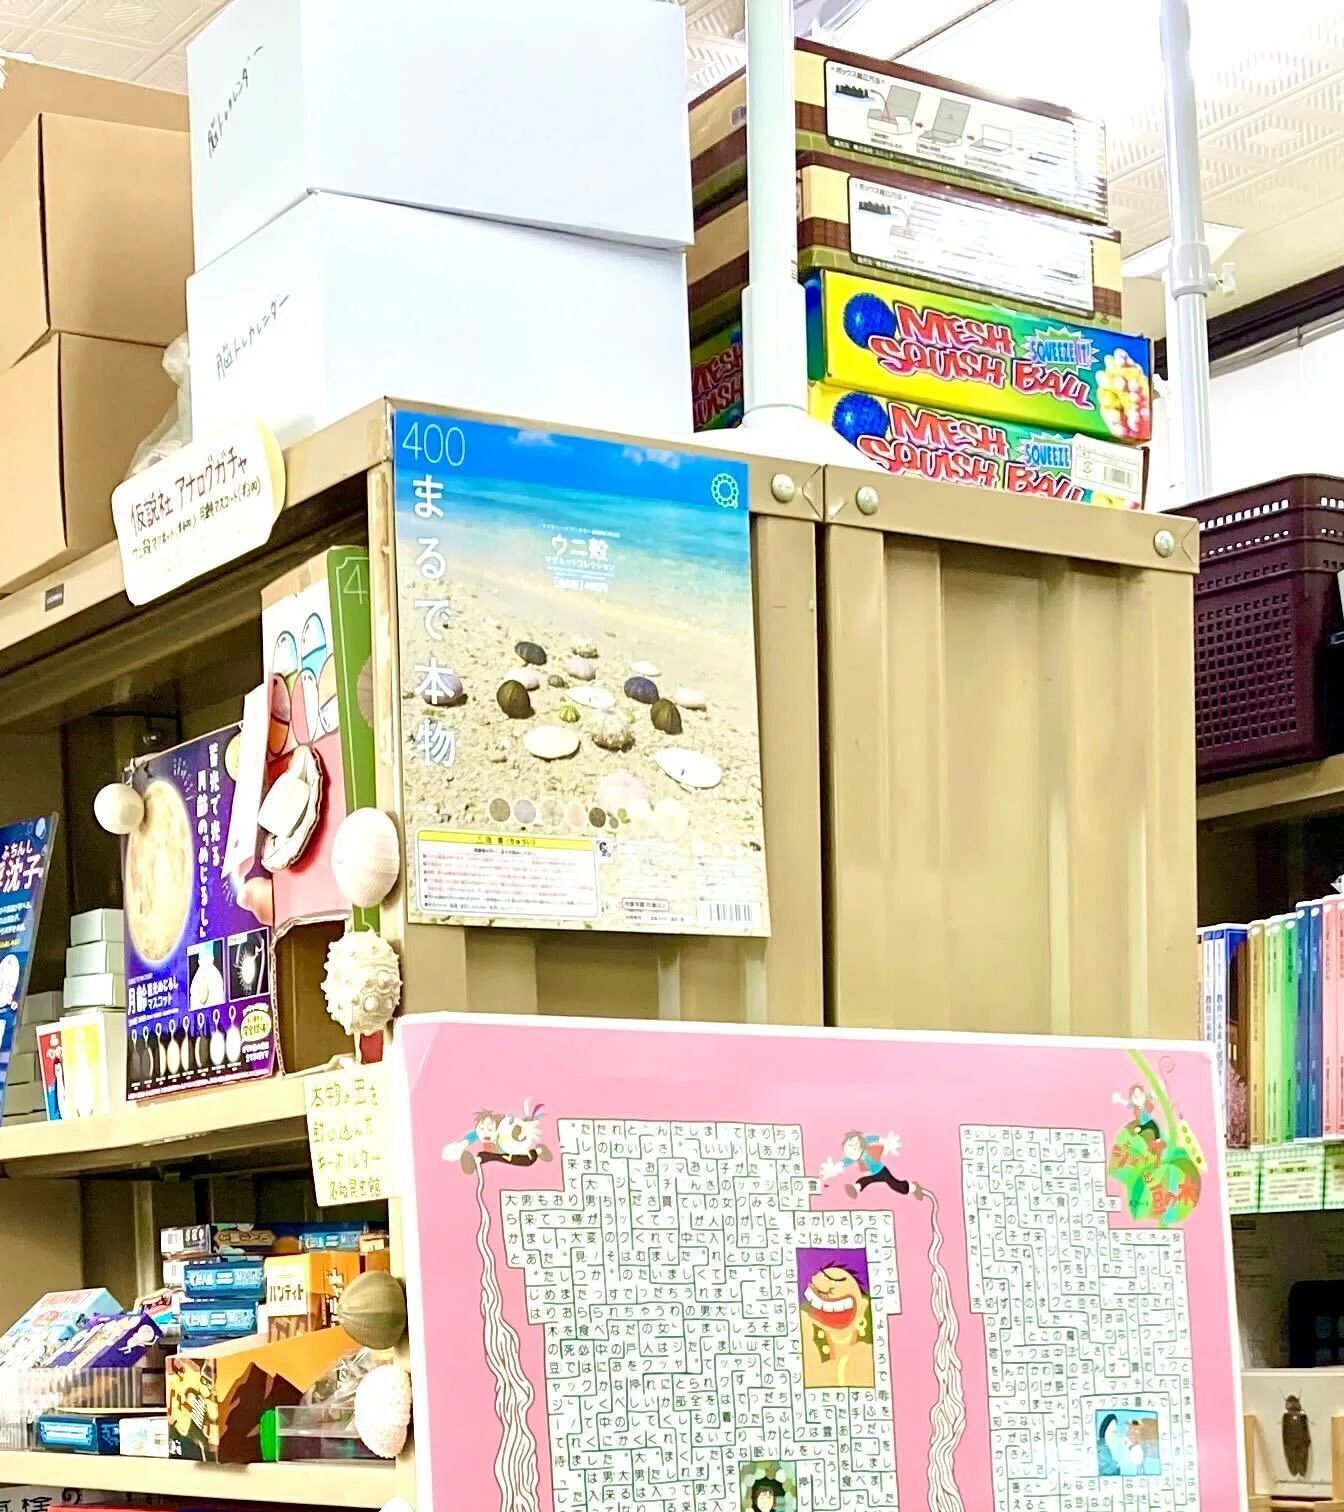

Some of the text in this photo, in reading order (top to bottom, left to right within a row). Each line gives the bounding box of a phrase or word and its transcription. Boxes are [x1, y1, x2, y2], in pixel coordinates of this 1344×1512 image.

[892, 303, 1013, 356] MESH
[1029, 338, 1078, 366] SQUEEZE
[868, 336, 1094, 411] SQUISH BALL
[401, 422, 466, 467] 400
[888, 402, 1011, 458] MESH
[858, 436, 1084, 503] SQUISH BALL
[551, 535, 610, 563] ウニ殻
[412, 474, 457, 768] まるで本物
